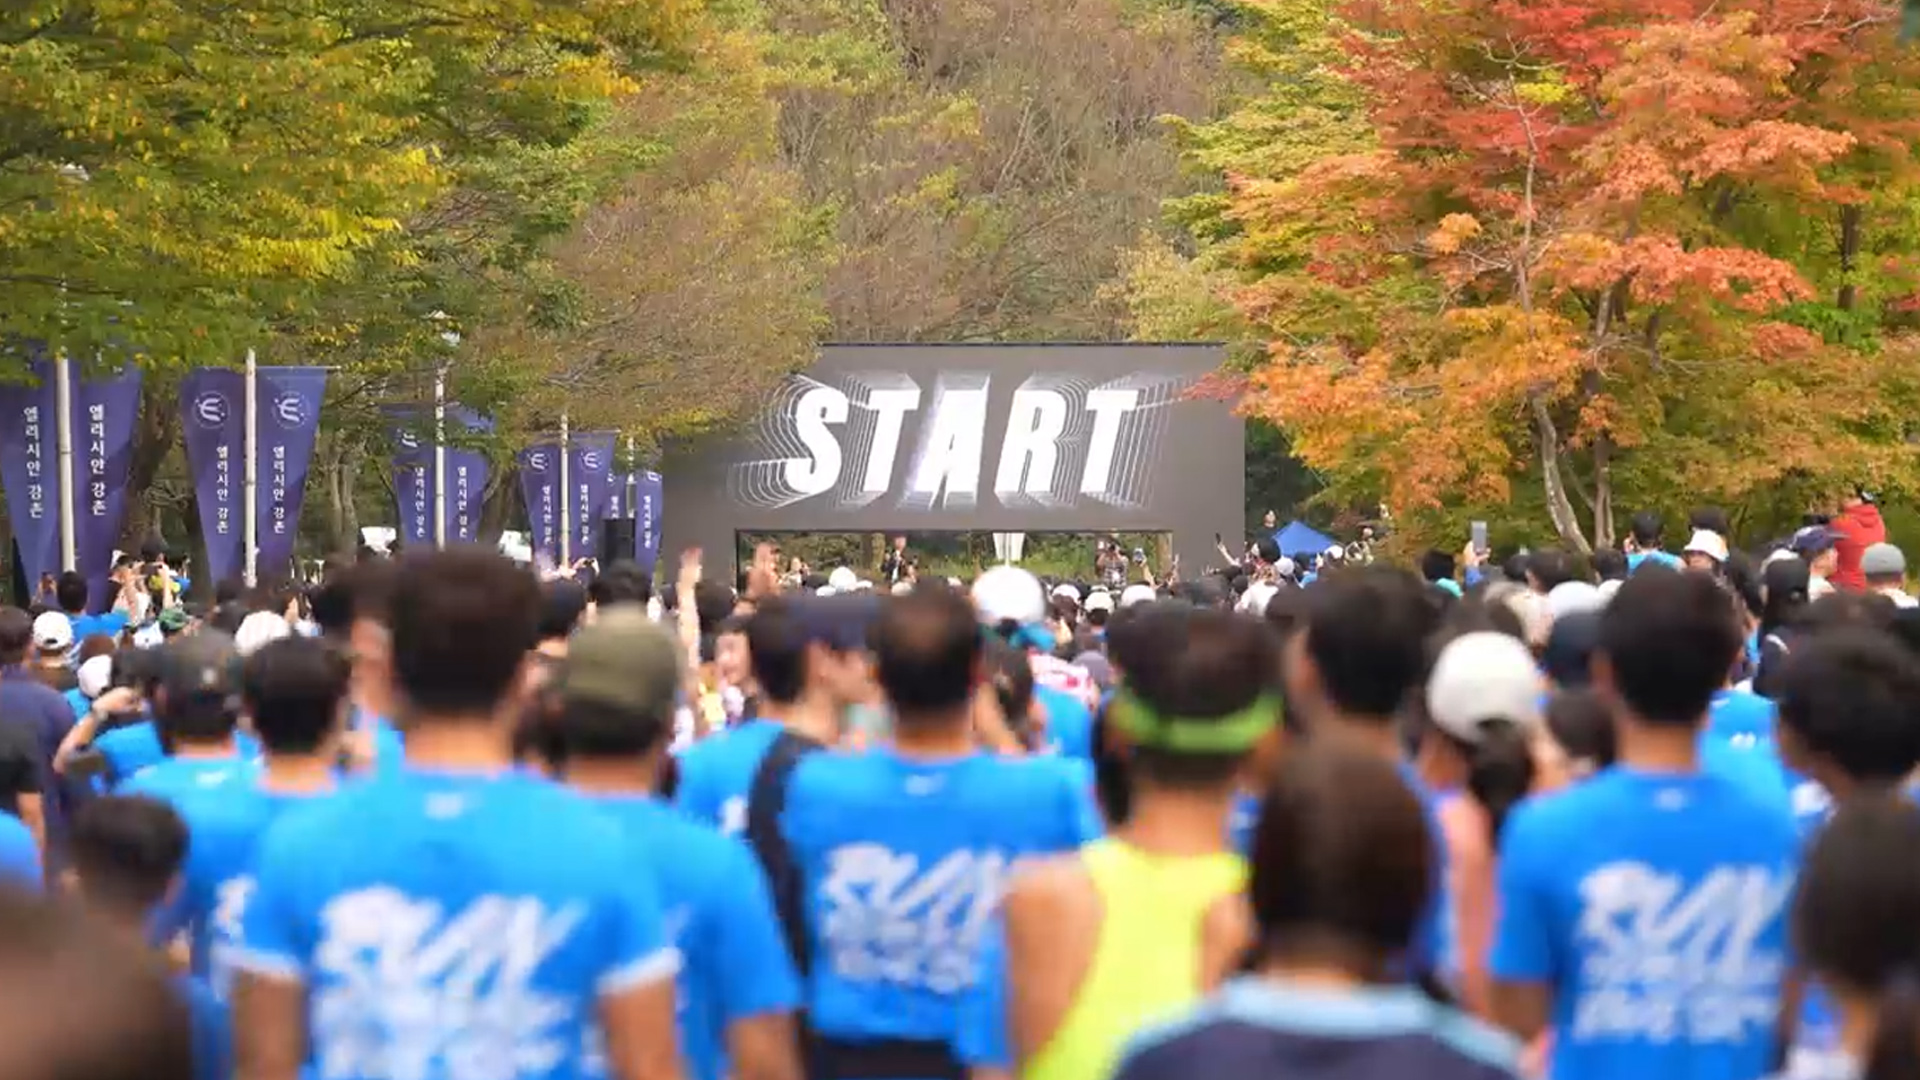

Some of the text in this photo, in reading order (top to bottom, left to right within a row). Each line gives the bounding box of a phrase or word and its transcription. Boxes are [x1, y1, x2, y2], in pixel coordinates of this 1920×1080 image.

[23, 405, 44, 518] 엘리시안 강촌
[89, 403, 106, 516] 엘리시안 강촌
[216, 445, 229, 534] 엘리시안 강촌
[273, 445, 285, 534] 엘리시안 강촌
[785, 386, 1140, 496] START
